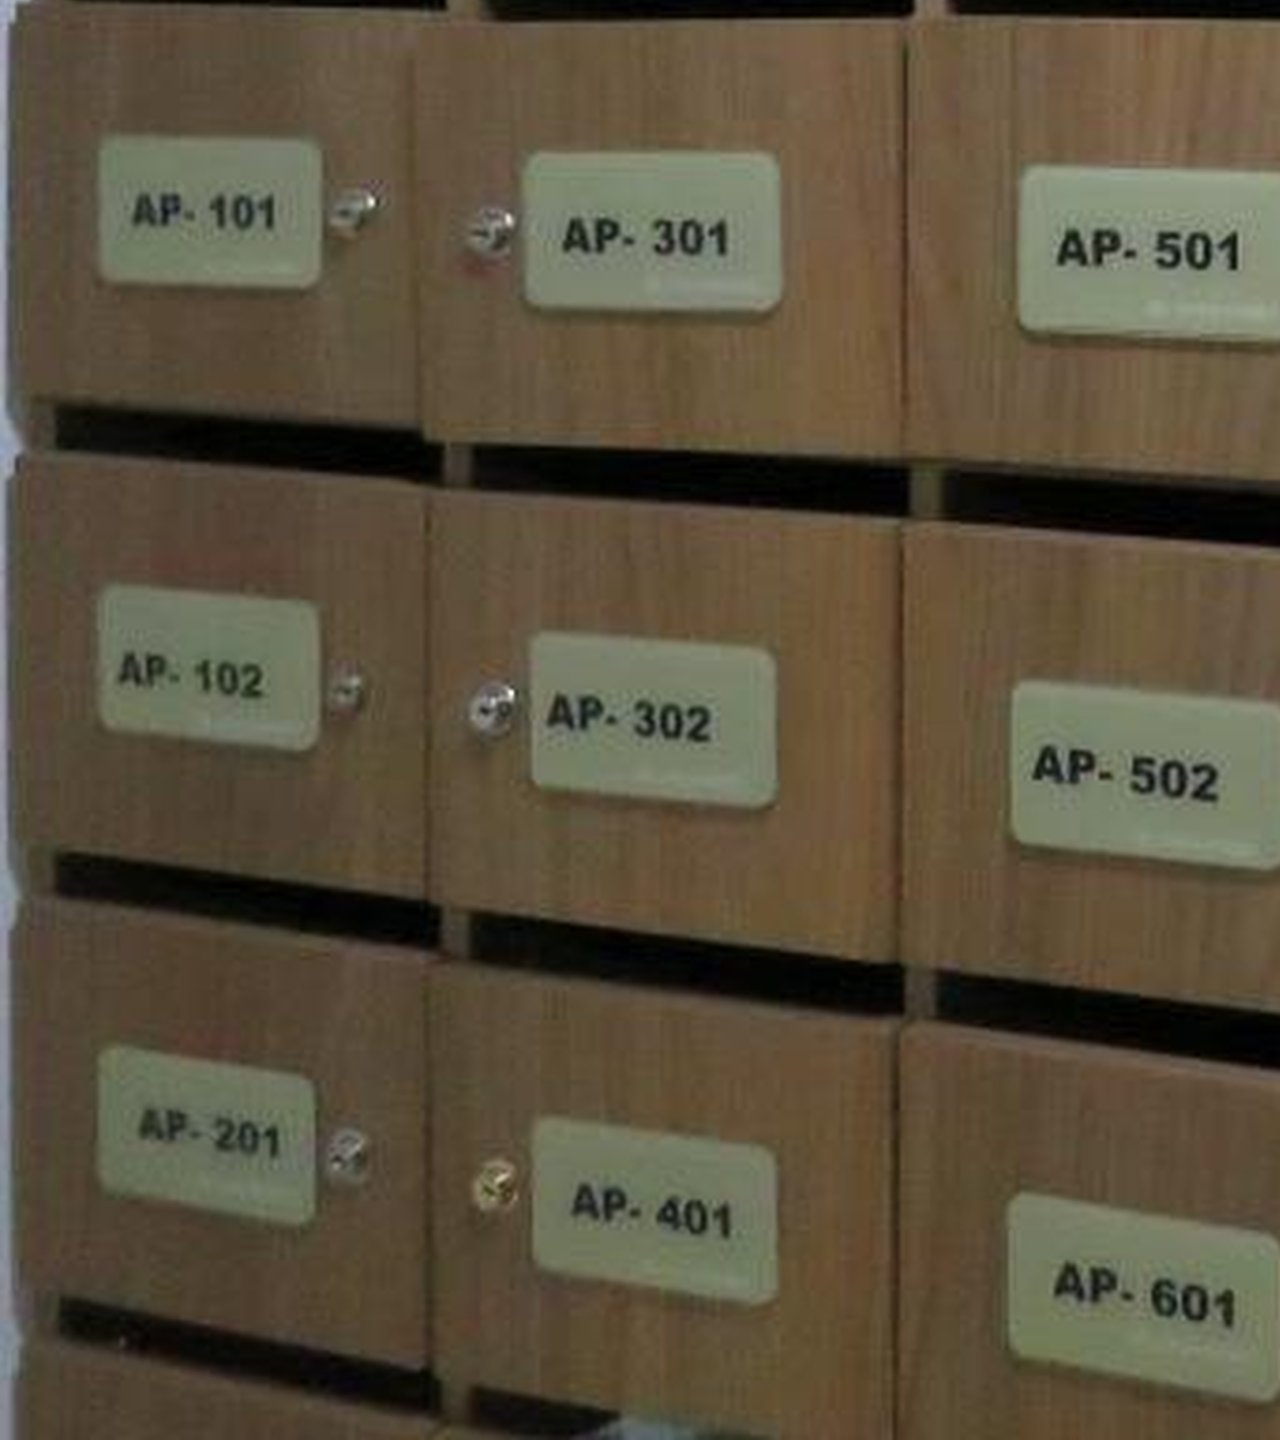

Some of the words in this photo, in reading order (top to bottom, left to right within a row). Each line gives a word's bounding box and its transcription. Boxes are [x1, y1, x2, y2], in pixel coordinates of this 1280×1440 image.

[132, 194, 196, 227] AP-
[209, 194, 277, 230] 101
[562, 219, 634, 255] AP-
[652, 220, 729, 257] 301
[1056, 229, 1138, 269] AP-
[1153, 233, 1241, 272] 501
[118, 652, 180, 686] AP-
[194, 660, 264, 698] 102
[547, 694, 617, 731] AP-
[634, 701, 711, 743] 302
[1032, 744, 1113, 784] AP-
[1129, 756, 1219, 802] 502
[138, 1106, 199, 1144] AP-
[213, 1116, 281, 1158] 201
[571, 1181, 641, 1224] AP-
[655, 1194, 732, 1239] 401
[1053, 1260, 1134, 1304] AP-
[1149, 1277, 1237, 1329] 601
